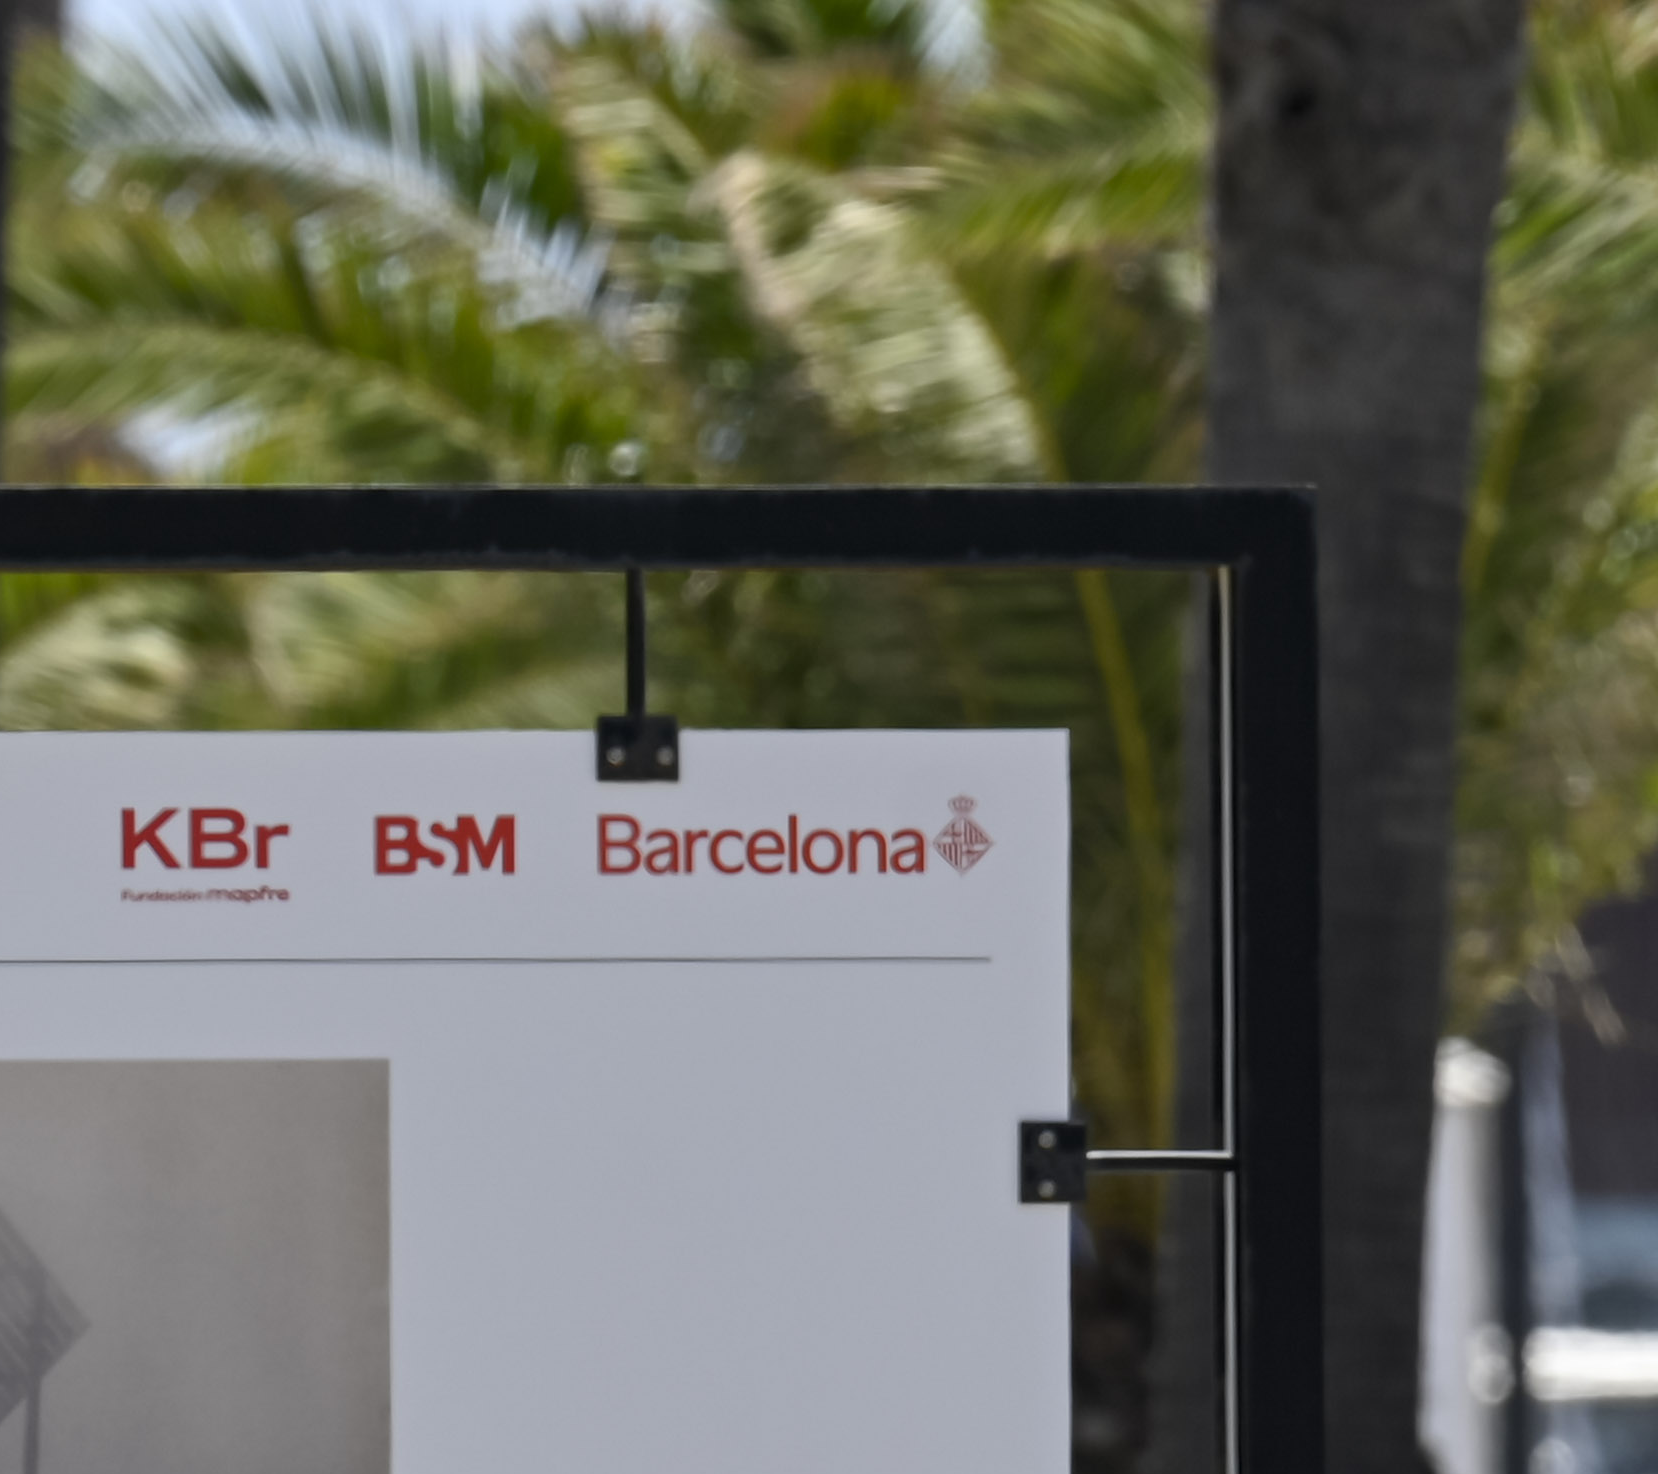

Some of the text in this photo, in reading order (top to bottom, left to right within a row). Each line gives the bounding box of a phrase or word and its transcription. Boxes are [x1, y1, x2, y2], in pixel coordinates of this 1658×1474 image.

[120, 806, 291, 870] KBr
[373, 813, 516, 876] BSM
[597, 812, 926, 876] Barcelona
